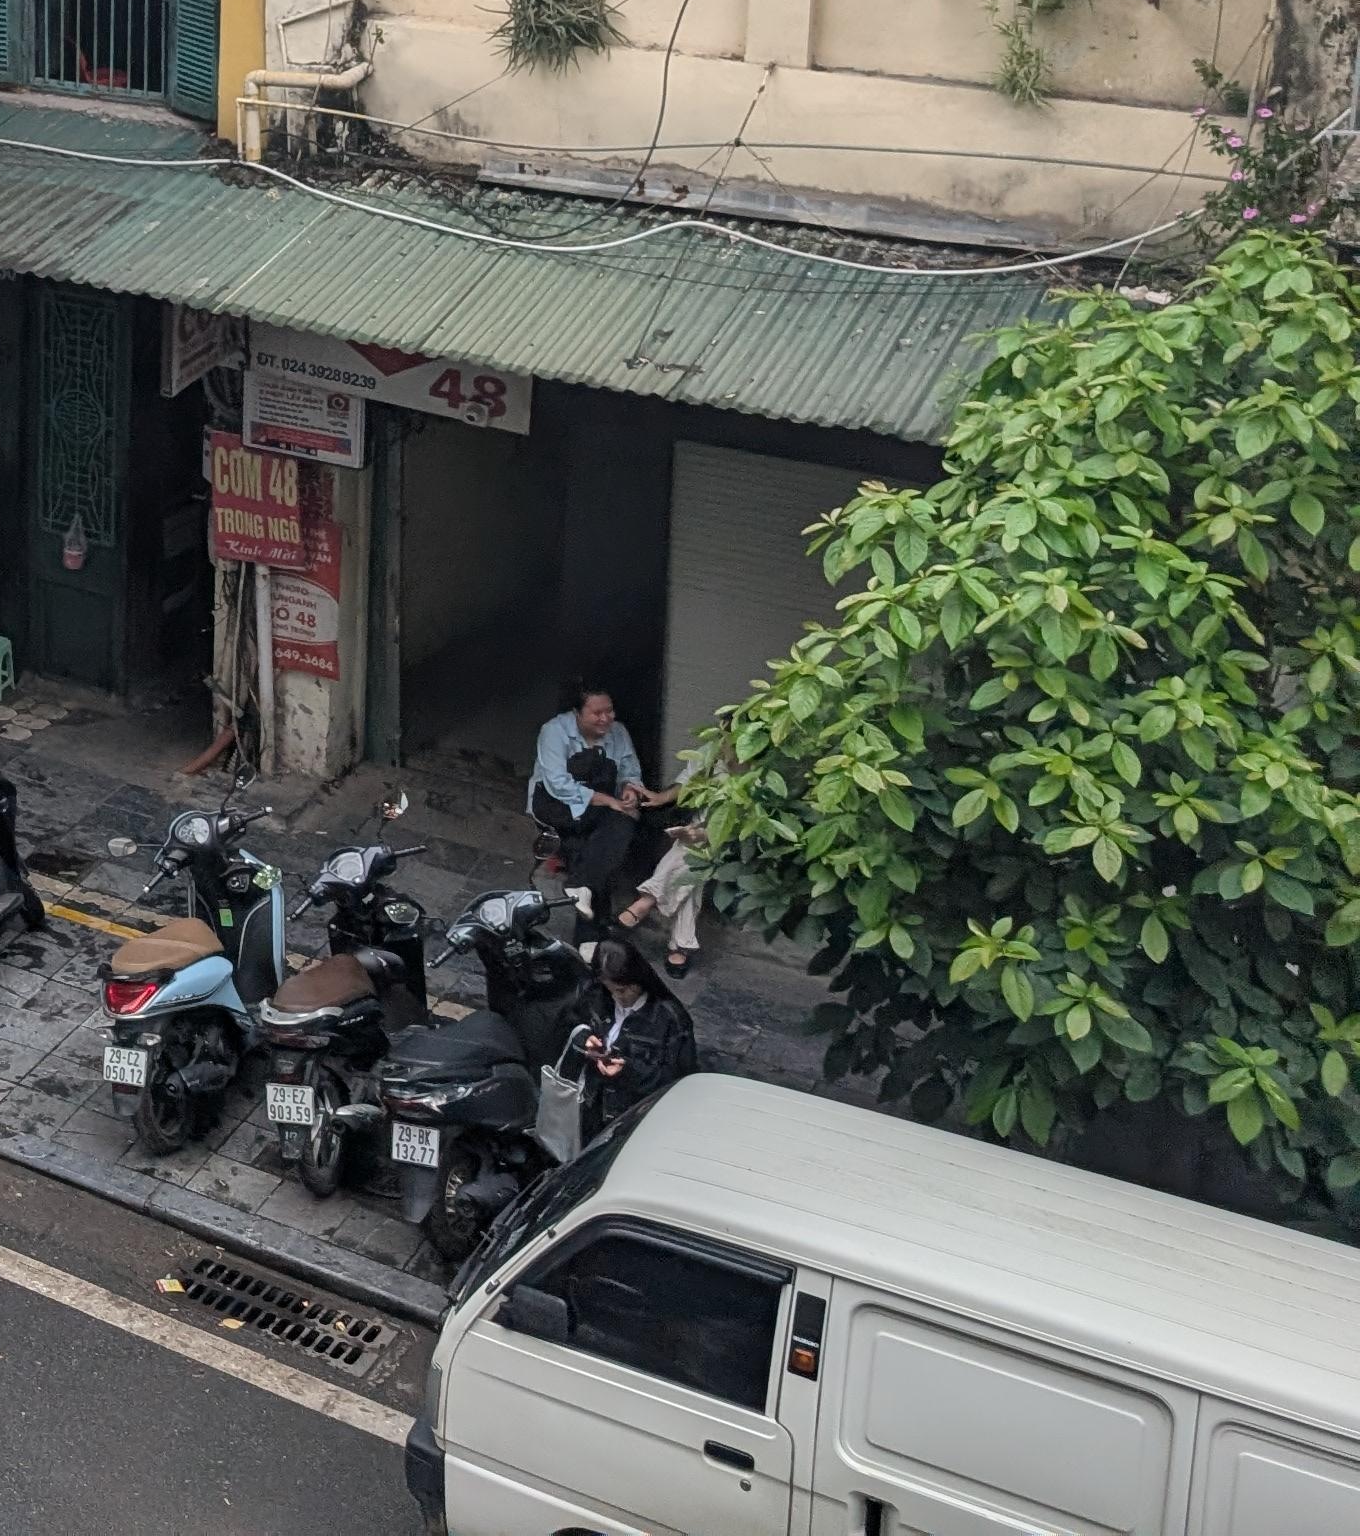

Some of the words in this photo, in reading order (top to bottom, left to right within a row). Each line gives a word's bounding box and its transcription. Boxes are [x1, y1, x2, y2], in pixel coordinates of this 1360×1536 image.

[429, 367, 507, 418] 48
[214, 446, 263, 502] CƠM
[269, 457, 298, 507] 48
[215, 507, 264, 539] TRONG
[267, 515, 301, 544] NGÕ
[295, 611, 316, 628] 48
[109, 1048, 140, 1067] 29-C2
[105, 1064, 143, 1084] 050.12
[272, 1087, 306, 1105] 29-E2
[270, 1104, 311, 1123] 903.59
[398, 1125, 432, 1146] 29-BK
[395, 1142, 435, 1164] 132.77
